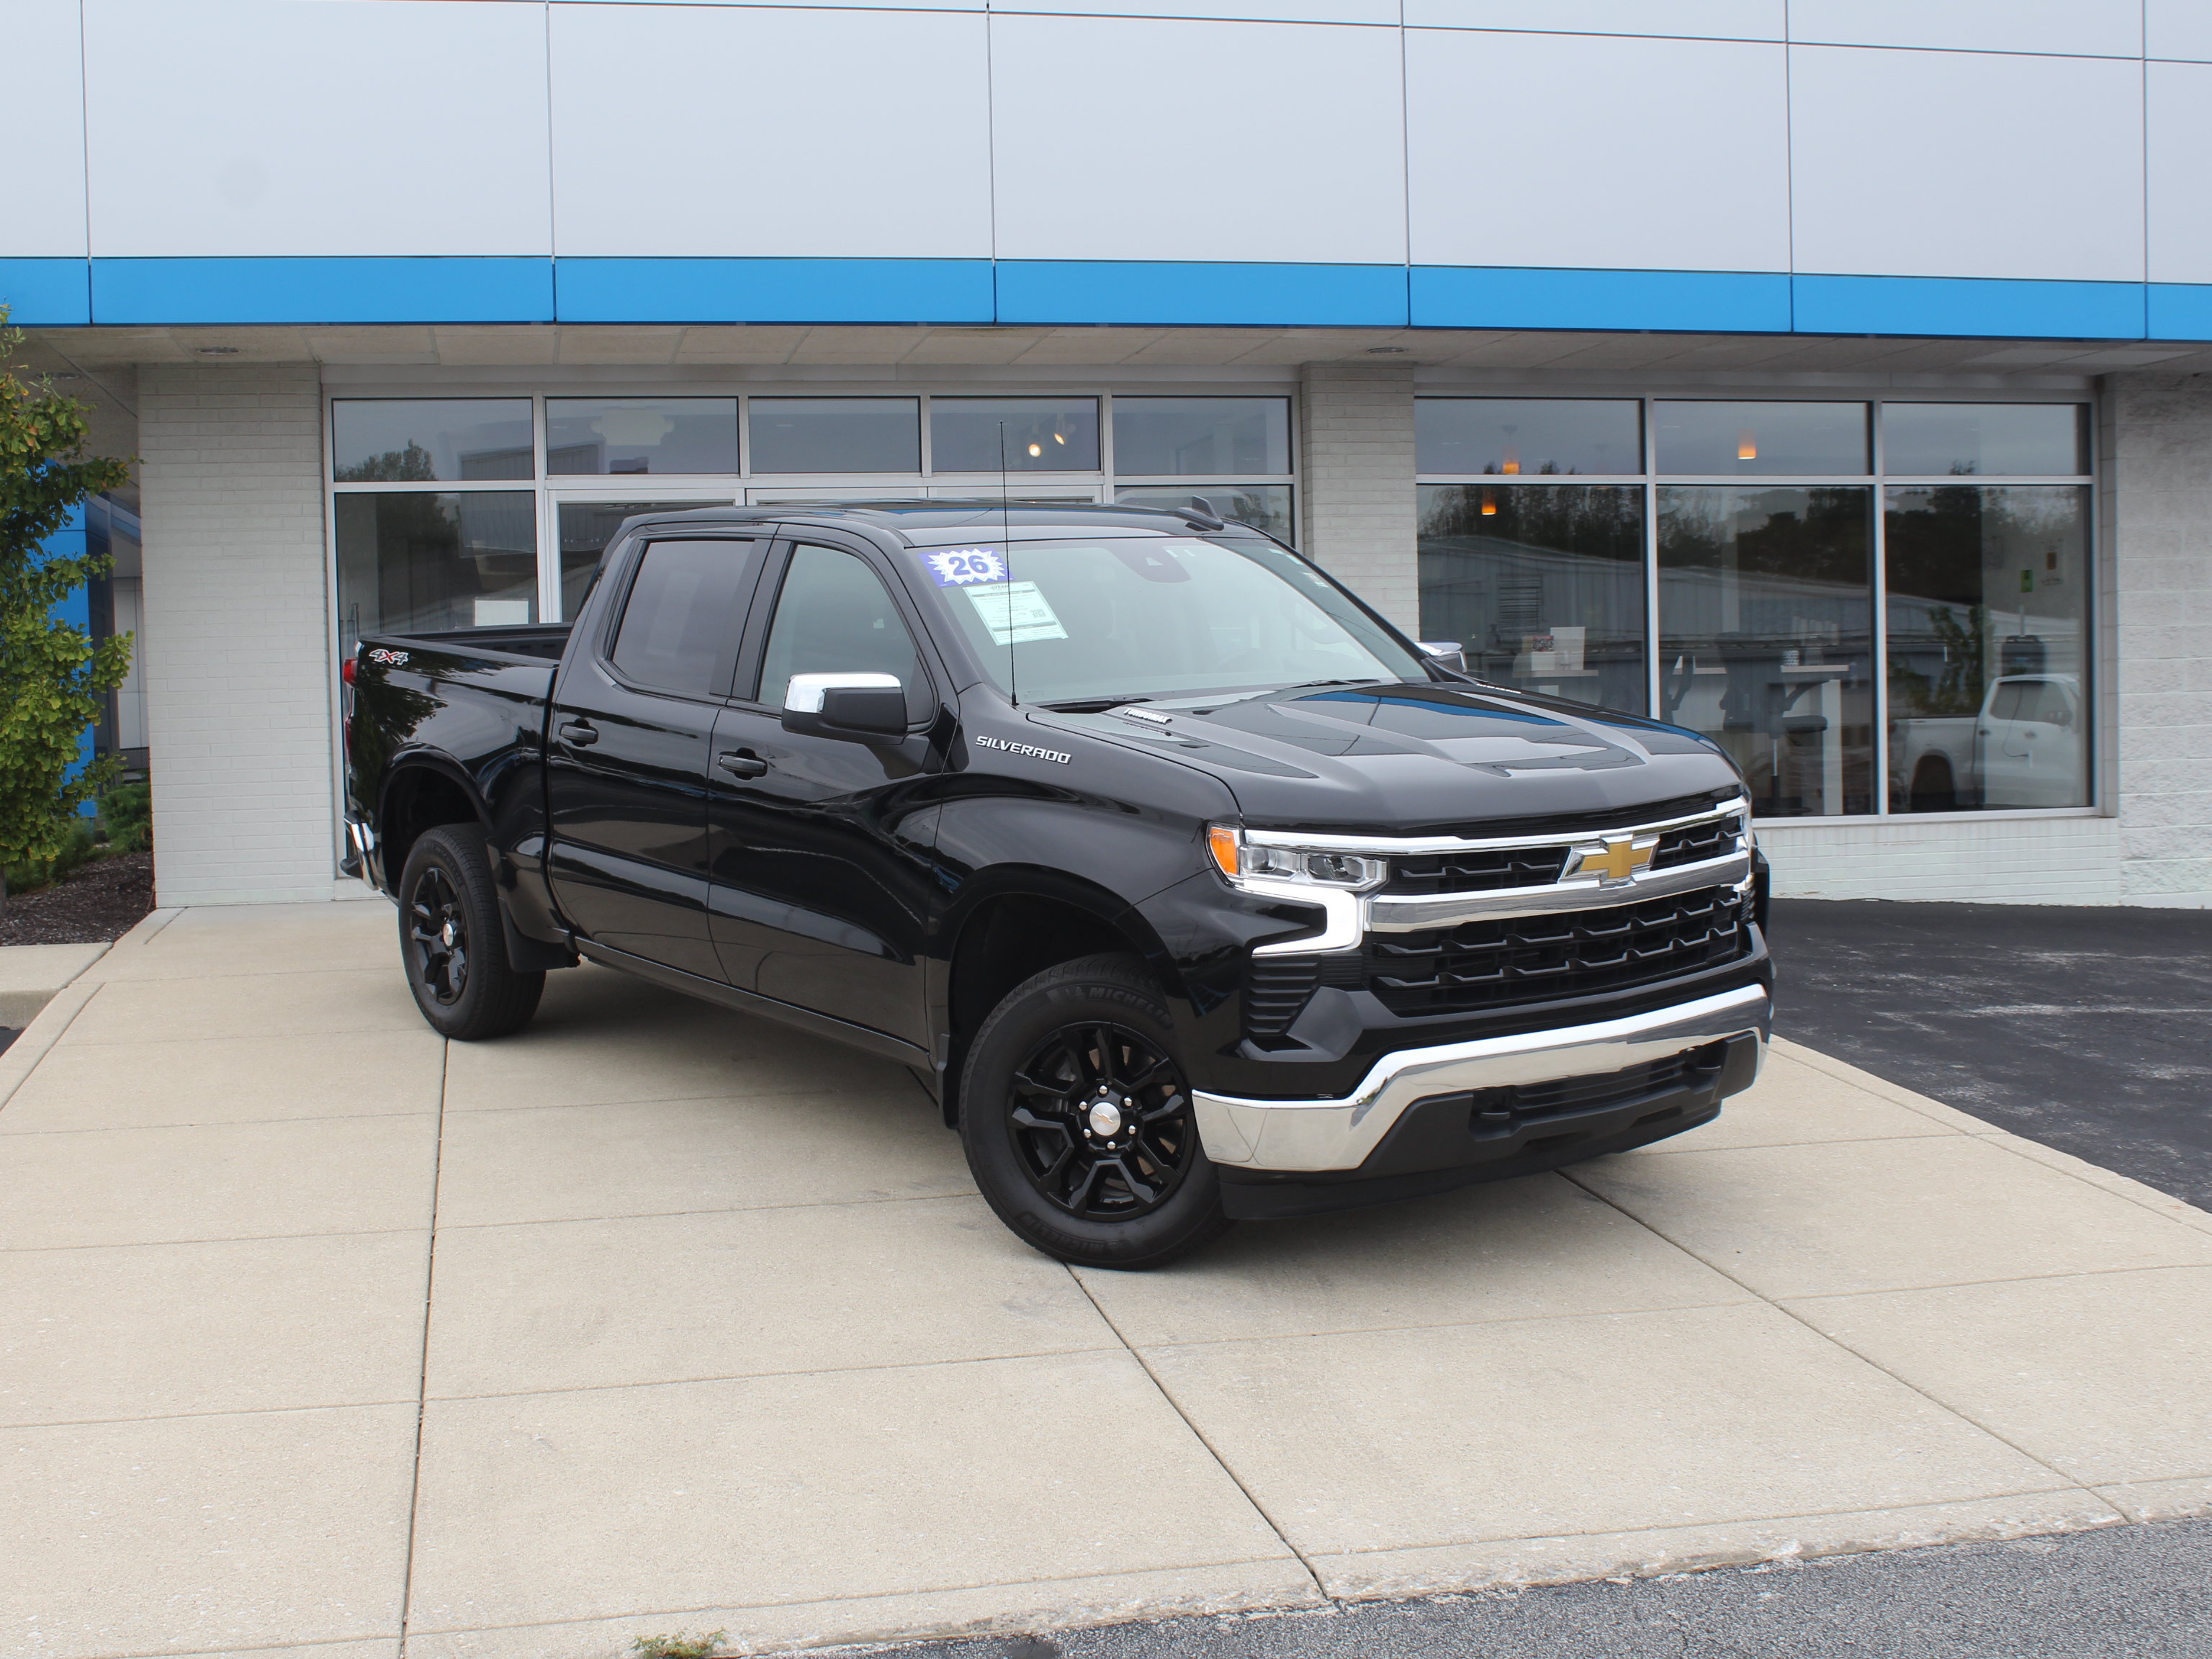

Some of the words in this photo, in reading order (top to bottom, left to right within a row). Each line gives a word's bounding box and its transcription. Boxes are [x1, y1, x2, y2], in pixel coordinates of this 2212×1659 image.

[948, 554, 989, 576] 26
[976, 735, 1071, 764] SILVERADO
[1089, 986, 1174, 1026] MICHELIN
